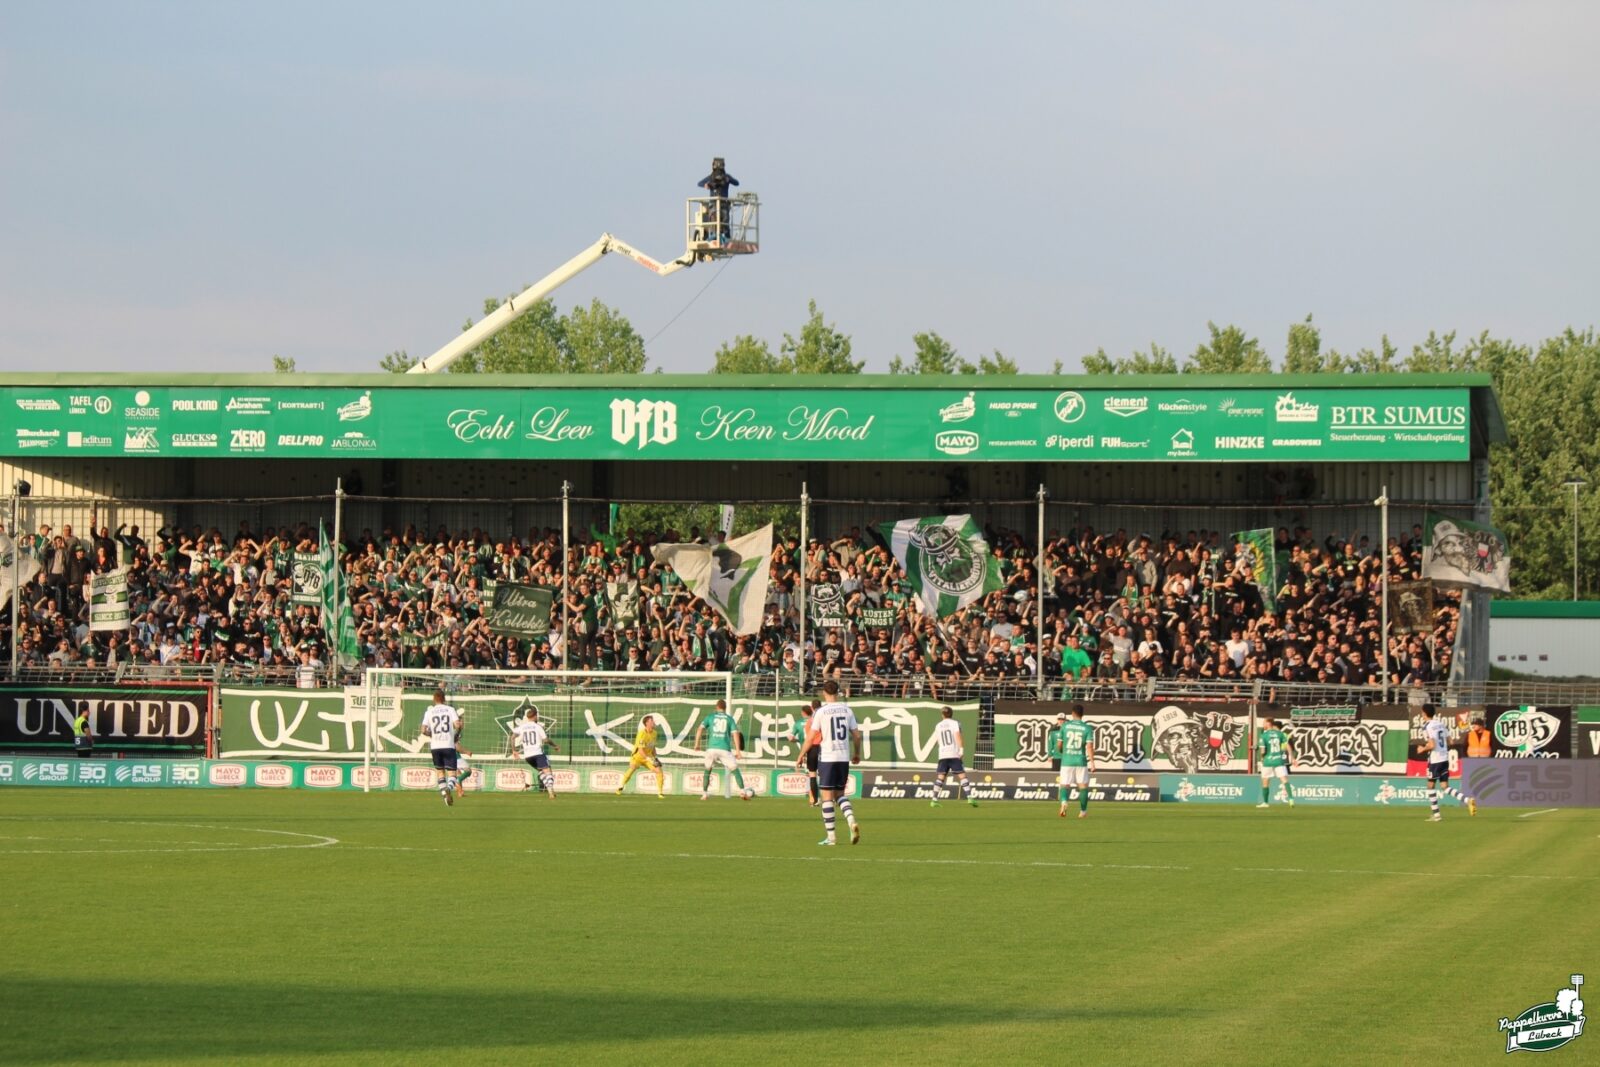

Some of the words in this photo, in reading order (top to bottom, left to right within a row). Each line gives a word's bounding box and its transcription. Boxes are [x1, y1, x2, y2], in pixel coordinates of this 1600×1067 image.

[69, 395, 92, 406] TAFEL
[1103, 396, 1149, 407] clement
[124, 407, 160, 417] SEASIDE
[1330, 406, 1378, 425] BTR
[1384, 406, 1466, 425] SUMUS
[447, 409, 515, 443] Echt
[525, 406, 595, 442] Leev
[609, 398, 677, 450] VfB
[695, 405, 776, 441] Keen
[782, 405, 875, 441] Mood
[277, 435, 324, 446] DELLPRO
[331, 439, 377, 448] JABLONKA
[939, 435, 975, 447] MAYO
[1058, 435, 1095, 451] iperdi
[1215, 436, 1265, 449] HINZKE
[1330, 432, 1386, 443] Steuerberatung
[1394, 432, 1466, 443] Wirtschaftsprüfung
[14, 698, 200, 738] UNITED
[432, 715, 450, 735] 23
[712, 717, 728, 733] 30
[830, 716, 847, 741] 15
[1500, 719, 1528, 738] VfB
[522, 731, 537, 746] 40
[941, 729, 953, 747] 10
[1066, 730, 1083, 749] 25
[1438, 730, 1444, 748] 5
[40, 763, 69, 776] FLS
[79, 766, 106, 779] 30
[132, 764, 162, 777] FLS
[172, 767, 199, 780] 30
[216, 767, 241, 775] MAYO
[261, 768, 286, 776] MAYO
[311, 768, 336, 777] MAYO
[357, 769, 382, 777] MYO
[406, 769, 432, 777] MAYO
[742, 775, 760, 783] AYO
[1507, 764, 1574, 790] FLS
[870, 786, 906, 798] bwin
[969, 787, 1005, 799] bwin
[1013, 788, 1050, 799] bwin
[1114, 789, 1151, 801] bwin
[1197, 786, 1244, 797] HOLSTEN
[1297, 787, 1344, 798] HOLSTEN
[1397, 788, 1445, 799] HOLSTN
[1507, 790, 1573, 802] GROUP
